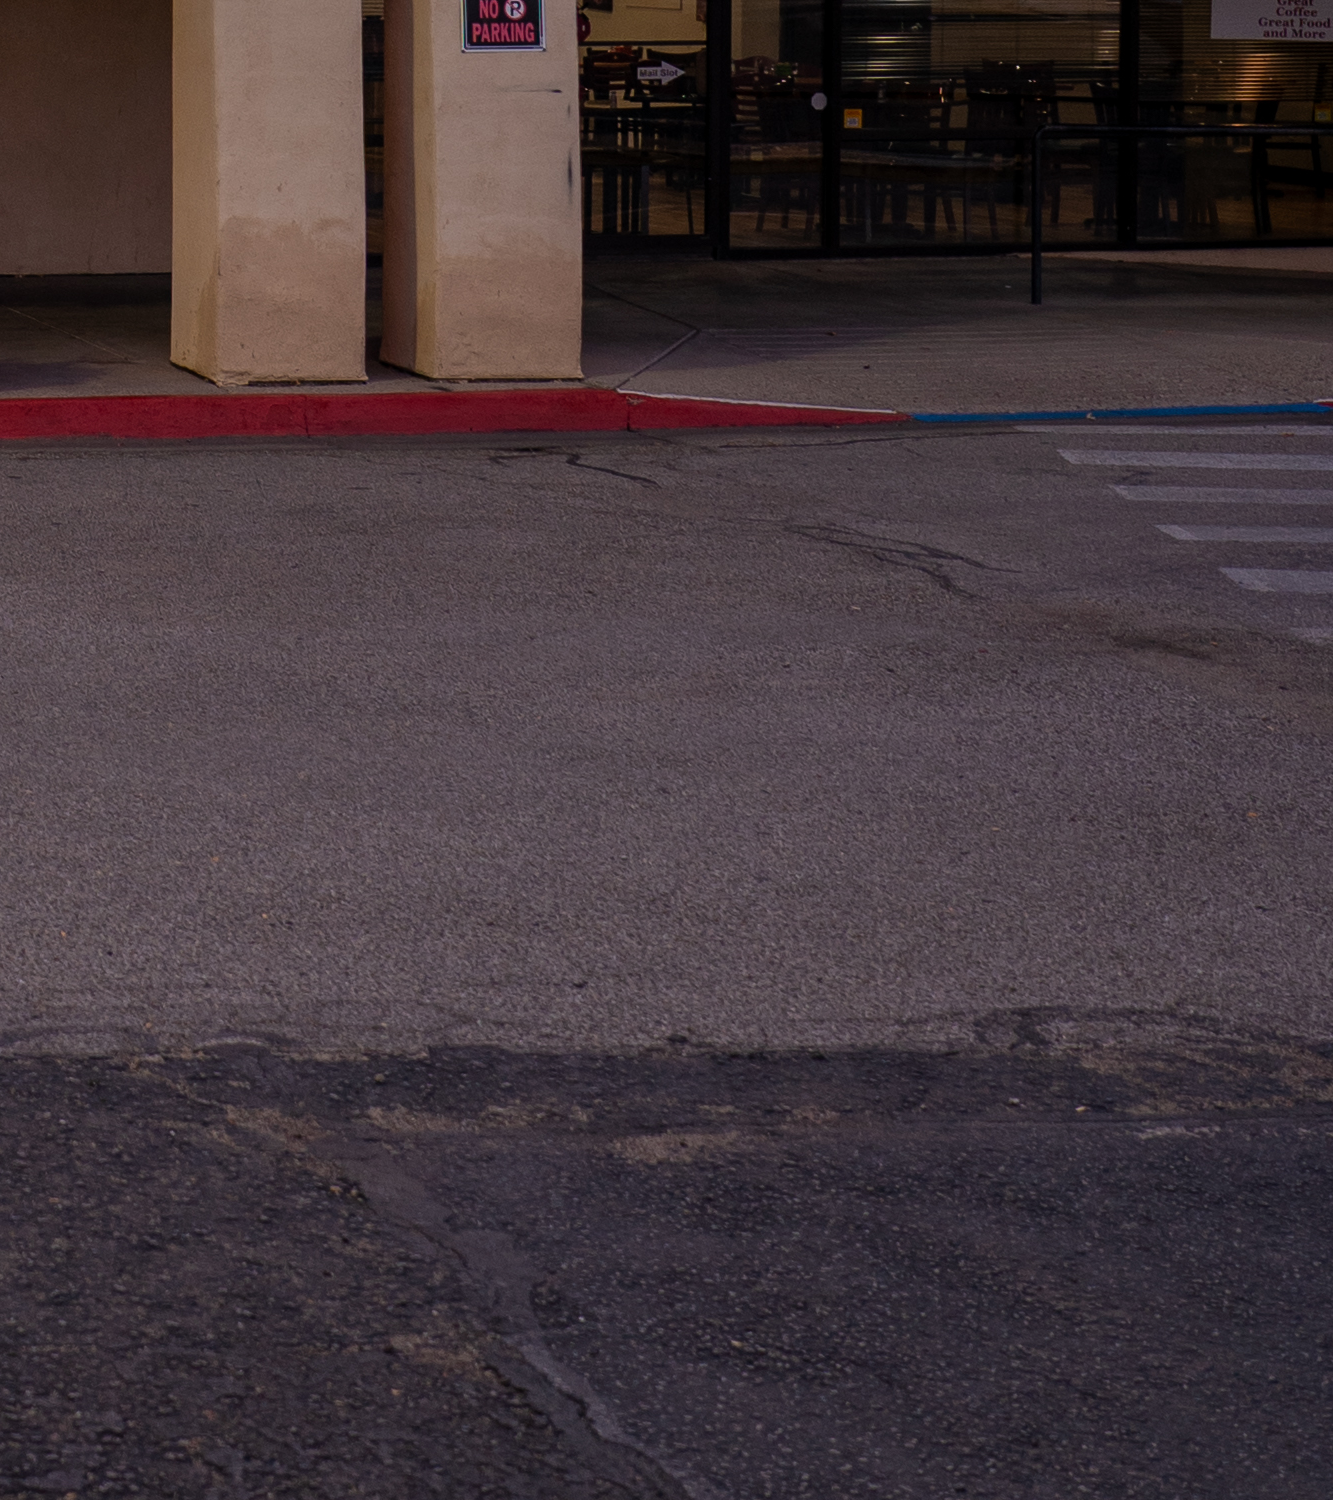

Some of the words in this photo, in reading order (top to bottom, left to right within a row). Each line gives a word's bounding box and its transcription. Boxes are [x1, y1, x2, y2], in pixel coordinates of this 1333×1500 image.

[1276, 7, 1318, 17] Coffee
[1258, 17, 1294, 27] Great
[1299, 18, 1331, 28] Food
[472, 22, 535, 43] PARKING
[1263, 28, 1287, 38] and
[1292, 29, 1326, 39] More
[660, 69, 679, 77] Slot
